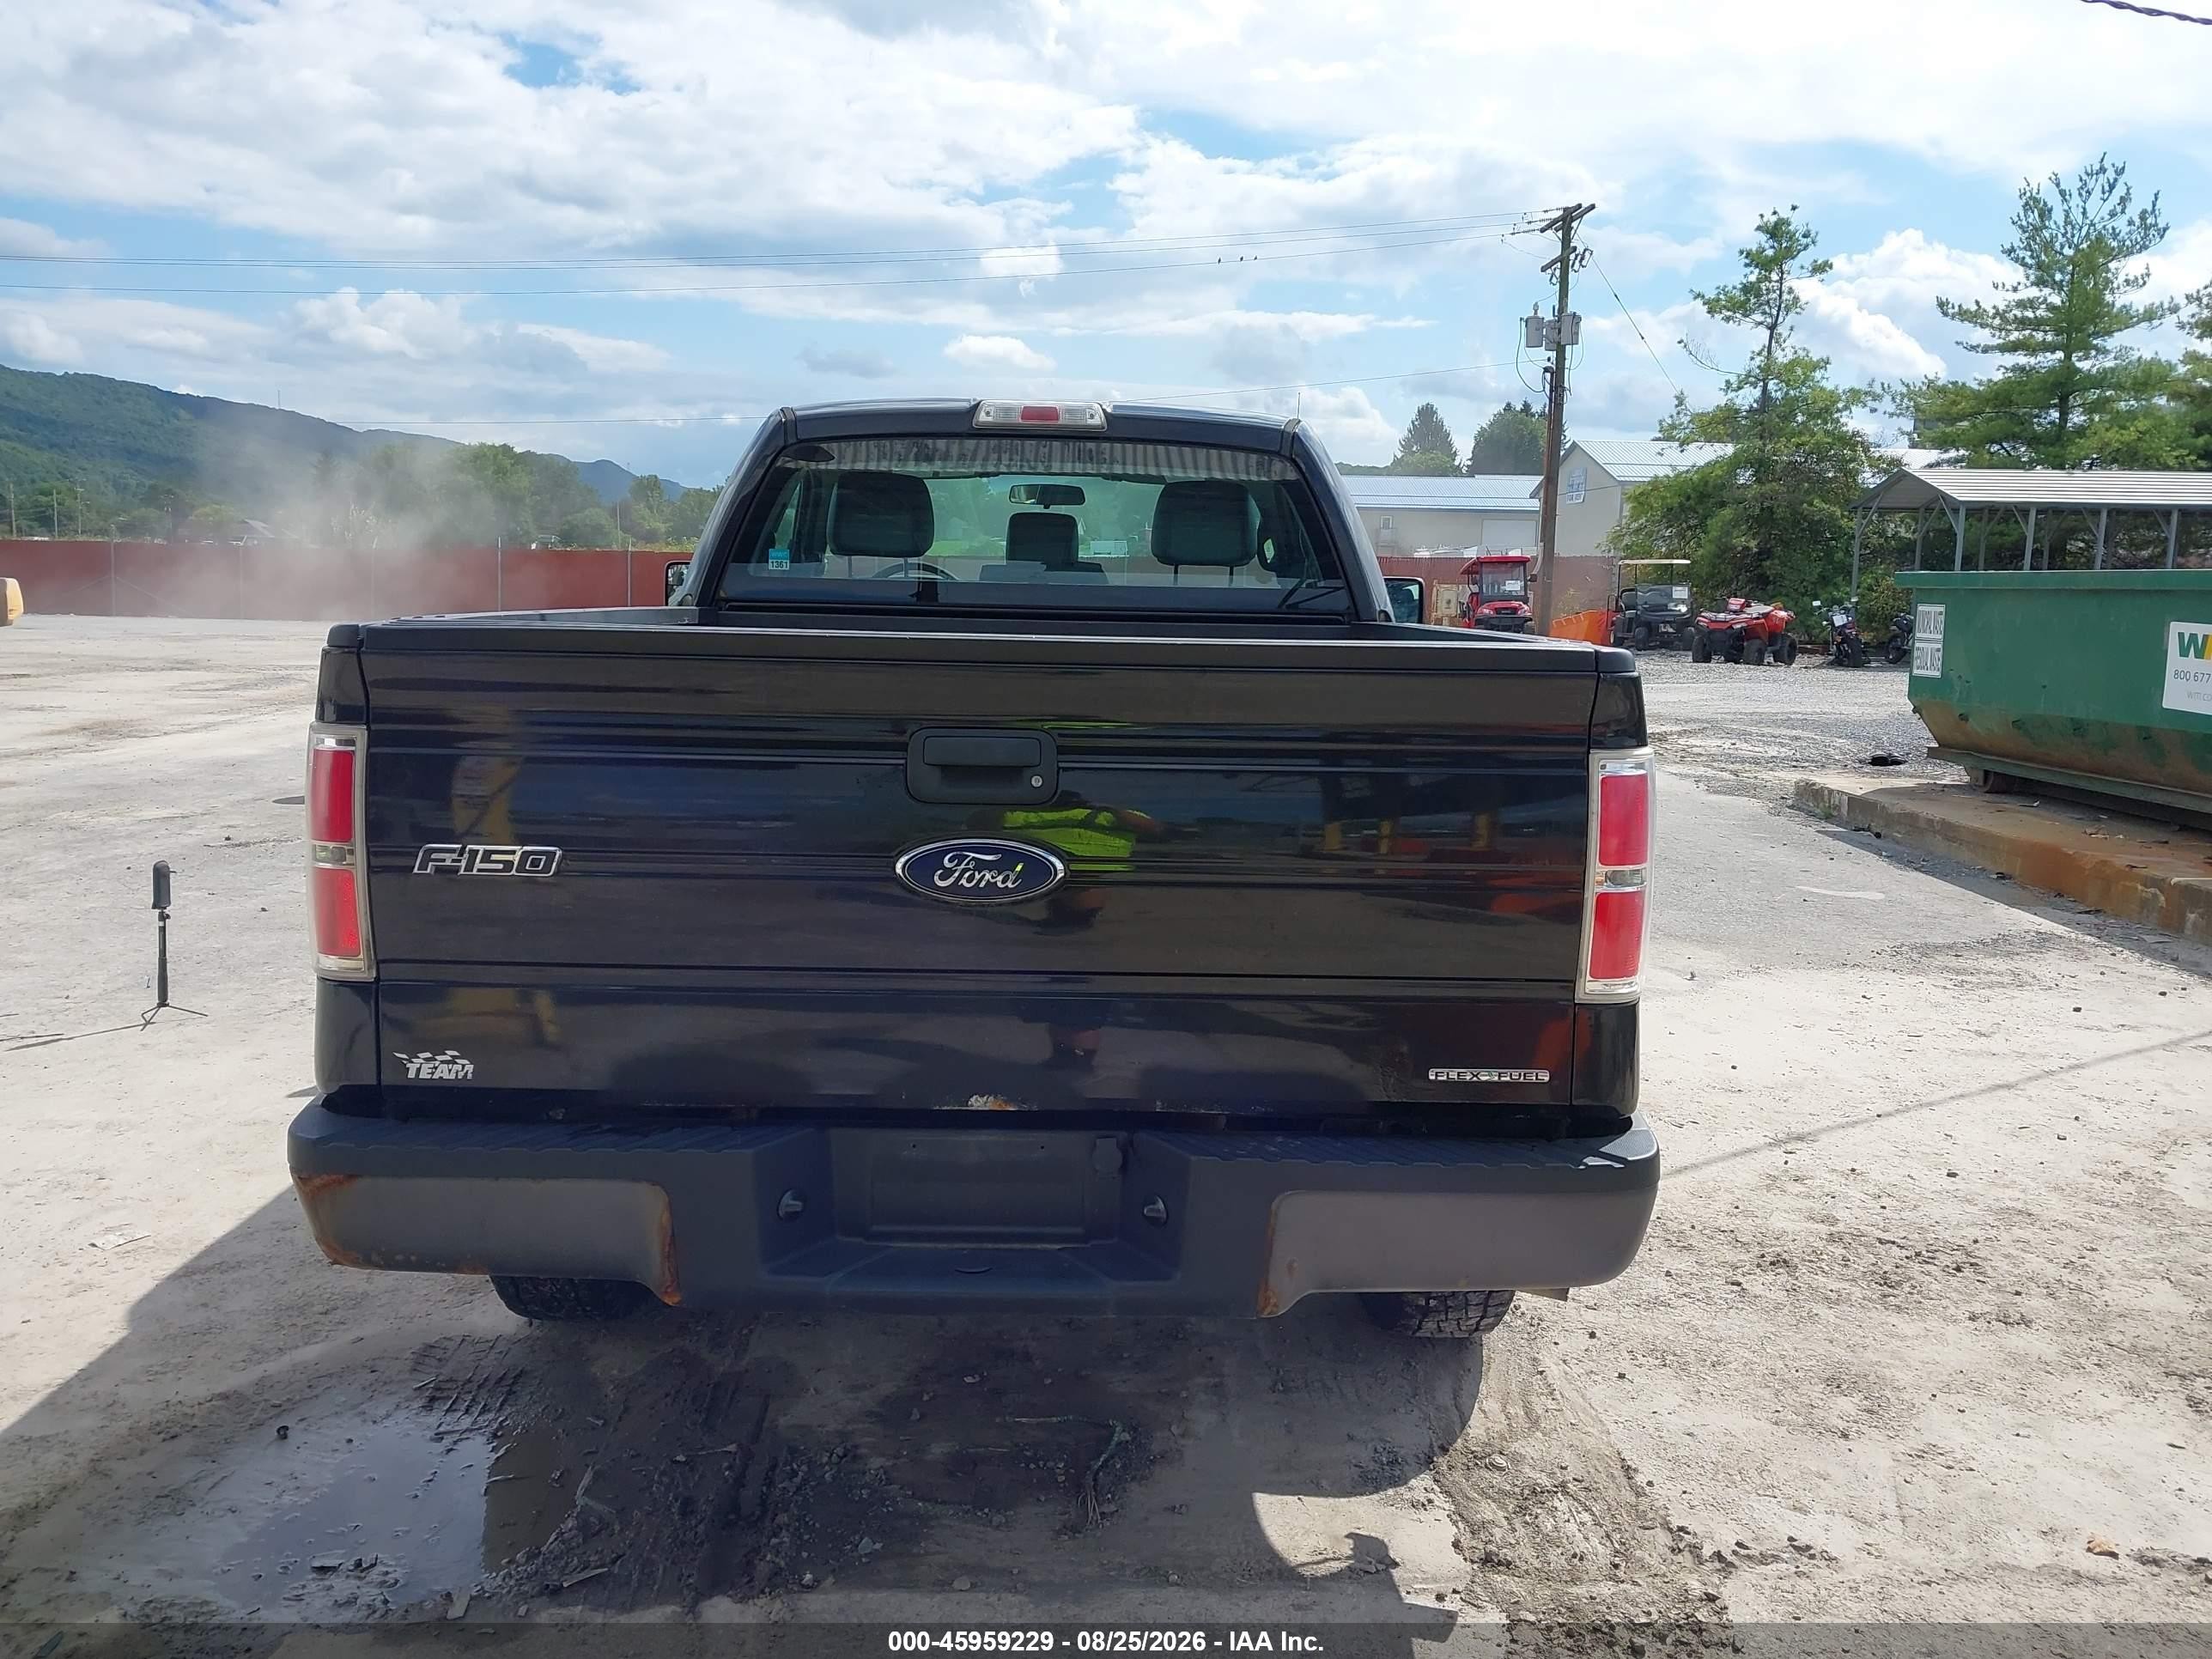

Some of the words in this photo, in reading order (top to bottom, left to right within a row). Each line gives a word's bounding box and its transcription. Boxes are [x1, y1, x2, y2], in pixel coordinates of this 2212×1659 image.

[2173, 670, 2191, 682] 800
[2193, 672, 2212, 684] 677
[413, 844, 563, 876] F-150
[933, 851, 1024, 889] Ford
[405, 1063, 474, 1079] TEAM
[1434, 1071, 1481, 1081] FLEX
[1498, 1071, 1546, 1081] FUEL
